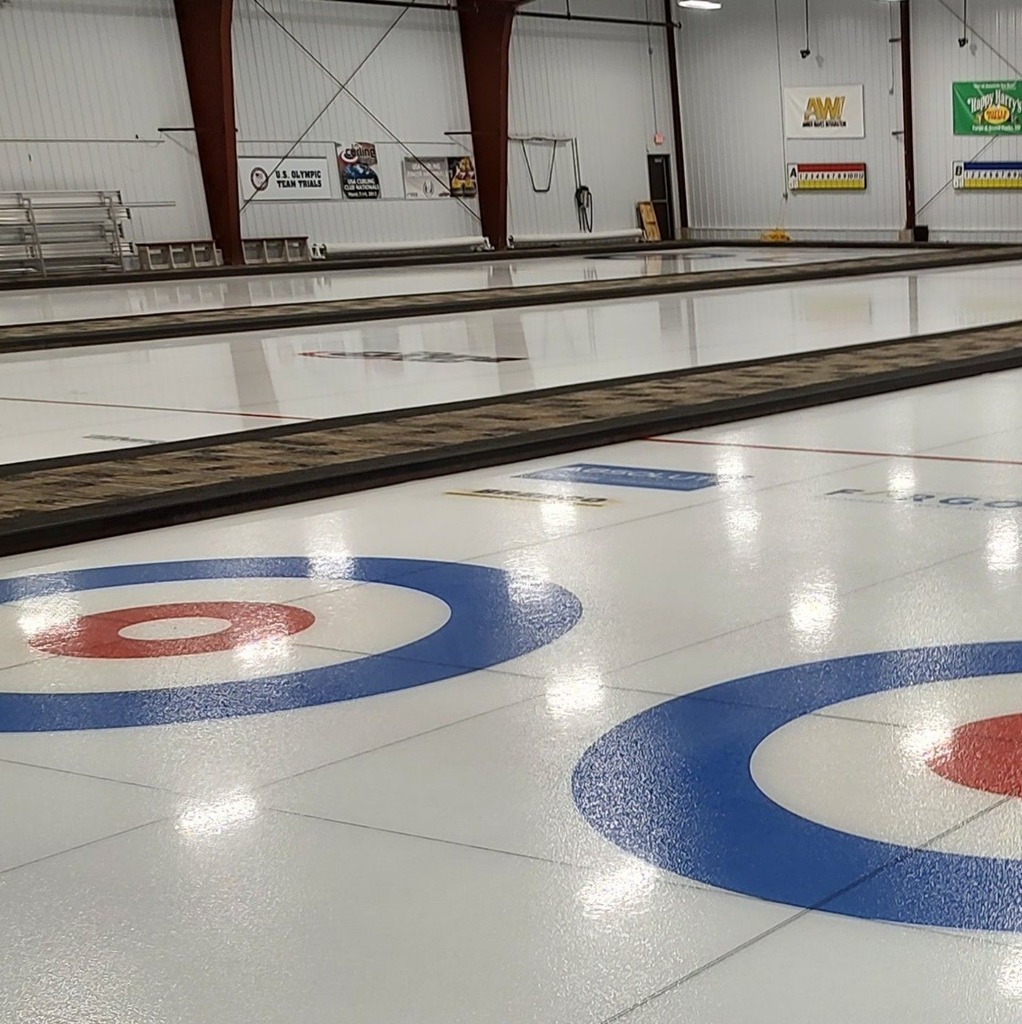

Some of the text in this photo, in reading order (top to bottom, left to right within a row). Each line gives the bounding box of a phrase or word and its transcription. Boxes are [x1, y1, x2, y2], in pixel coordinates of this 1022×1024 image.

[967, 89, 1022, 114] Happy Harry's
[275, 170, 322, 179] U.S. OLYMPIC
[790, 167, 797, 178] A
[955, 166, 963, 176] B
[276, 180, 322, 188] TEAM TRIALS
